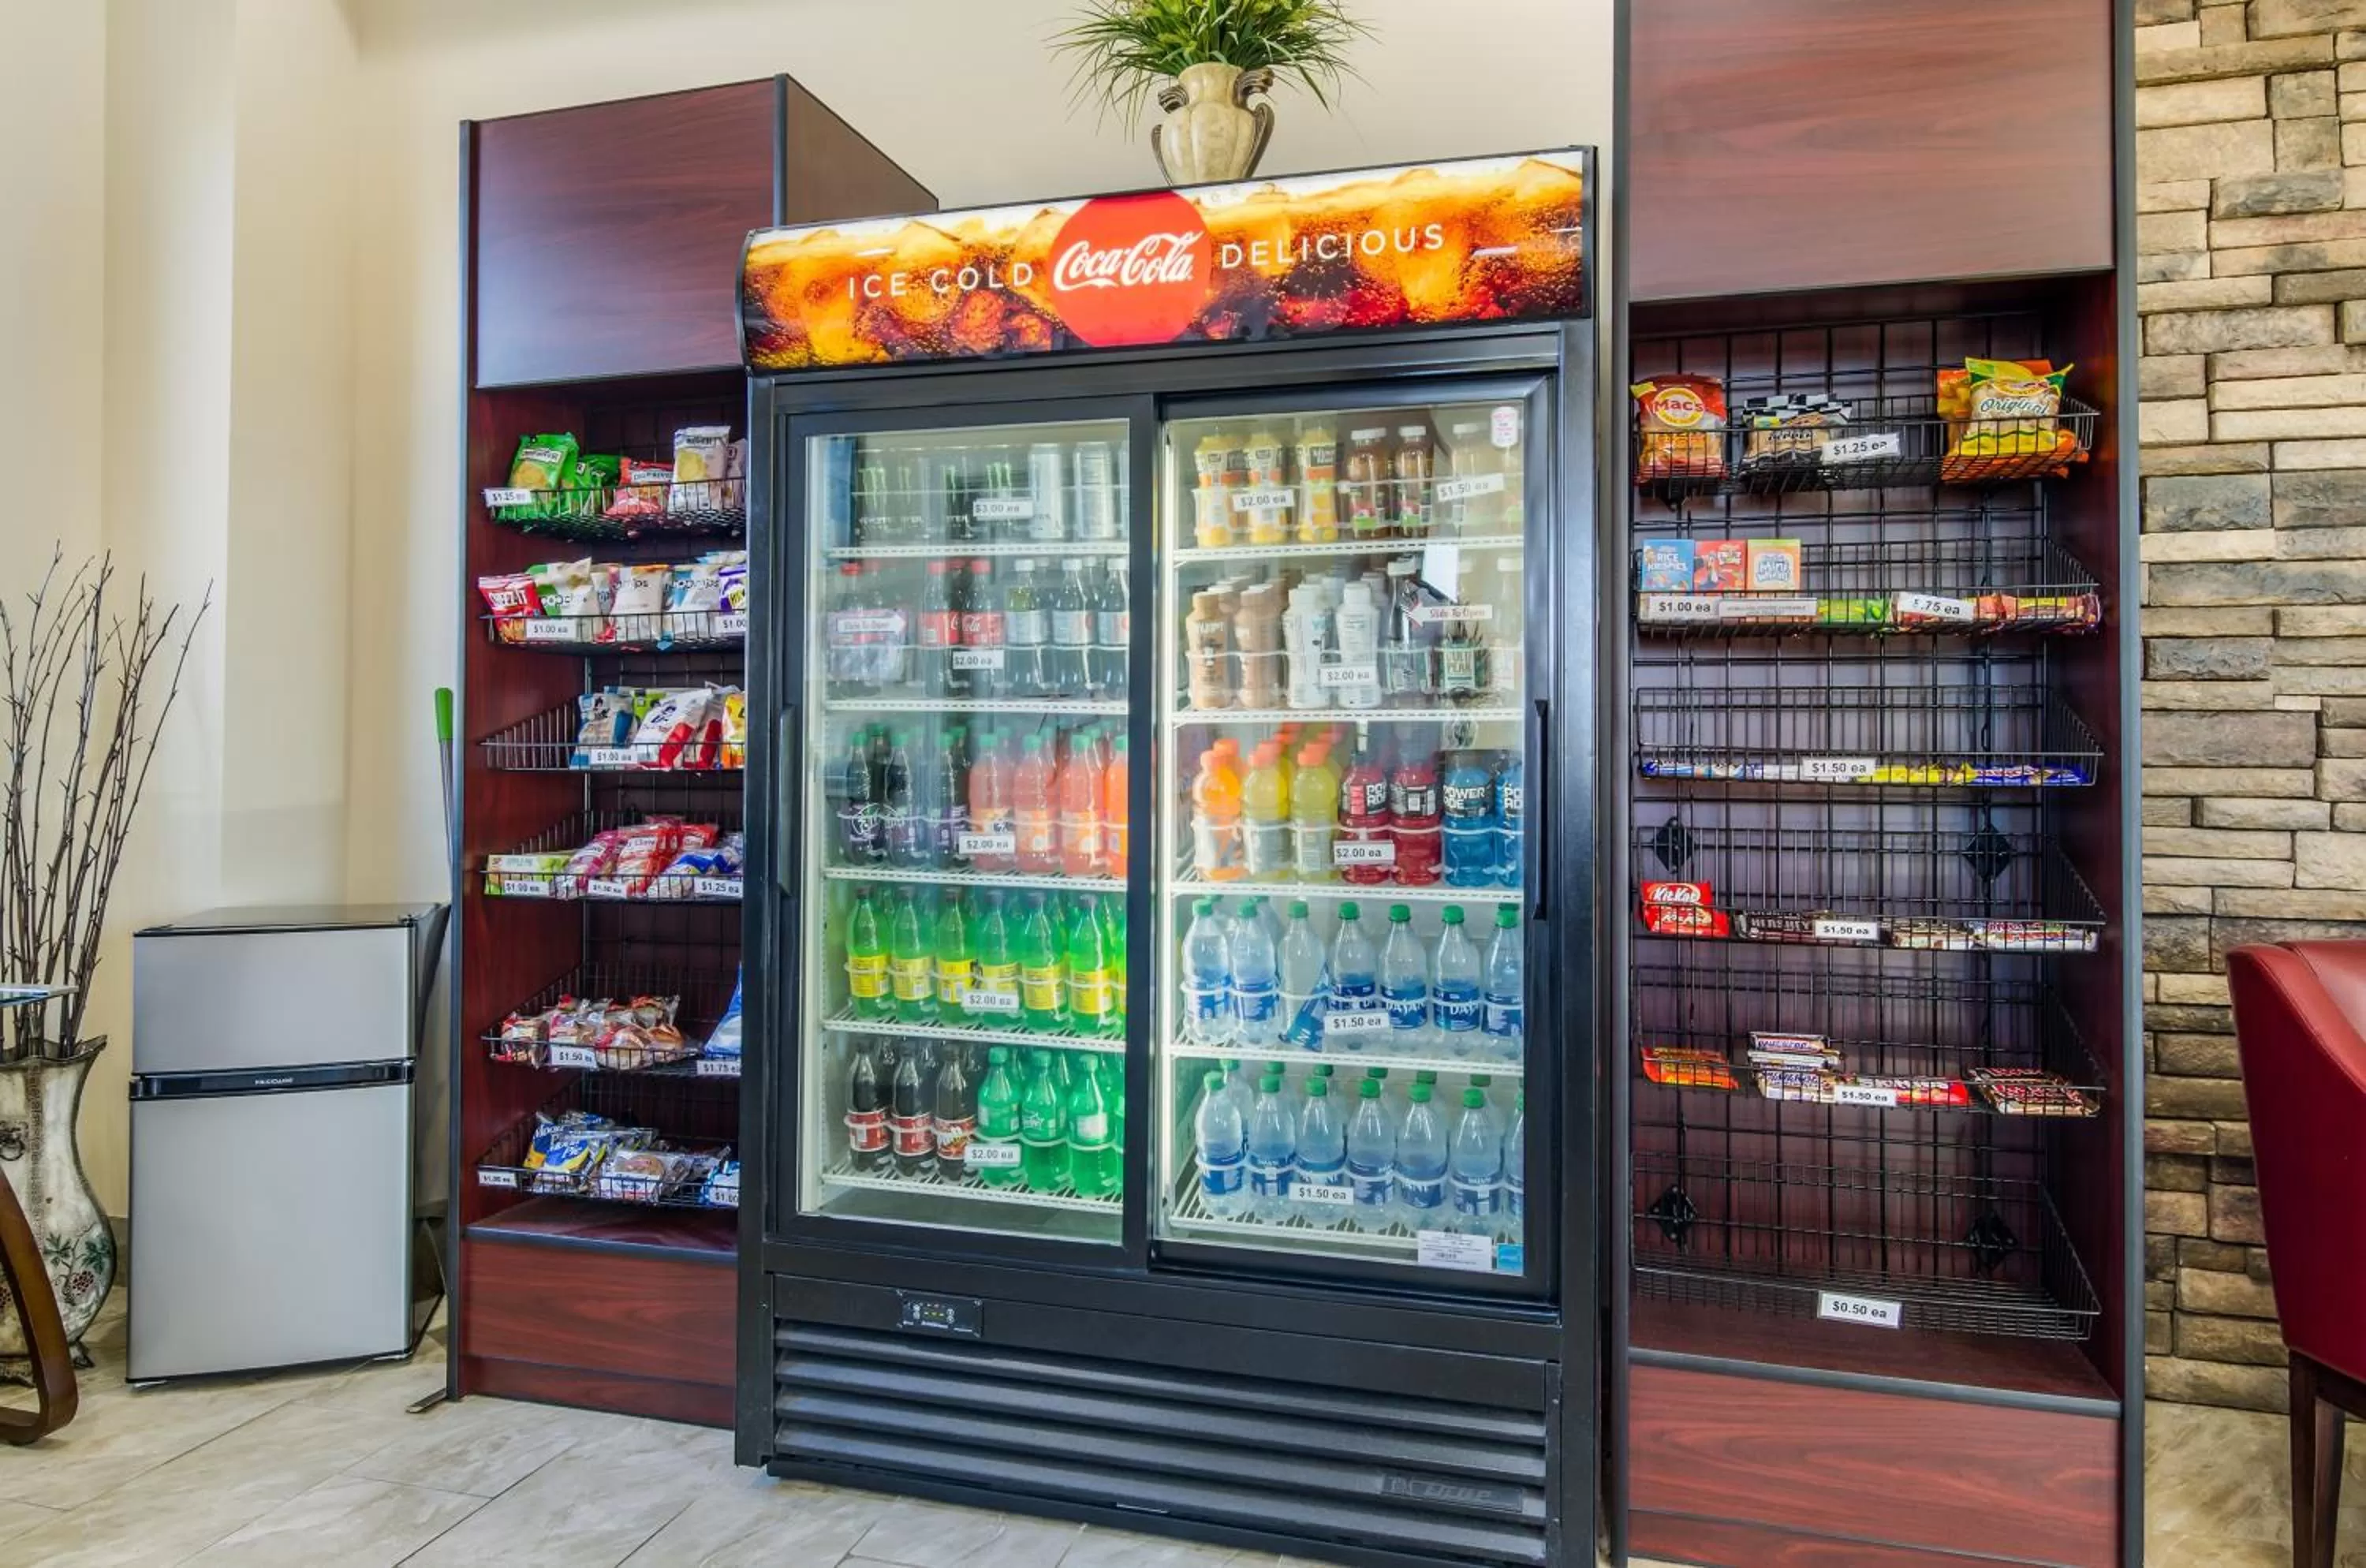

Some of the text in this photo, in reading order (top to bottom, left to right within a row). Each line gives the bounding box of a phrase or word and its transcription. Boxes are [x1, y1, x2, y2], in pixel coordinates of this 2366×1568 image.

[1221, 223, 1446, 271] DELICIOUS
[1053, 228, 1205, 293] Coca-Cola
[847, 262, 1036, 301] ICE COLD
[1655, 398, 1704, 412] Mac's
[1980, 397, 2051, 416] Original
[1832, 439, 1887, 456] $1.25 ea
[1440, 483, 1472, 499] $1.50
[1240, 495, 1271, 507] $2.00
[1659, 602, 1711, 612] $1.00 ea
[1944, 605, 1960, 615] ea
[954, 656, 979, 666] $2.00
[1326, 670, 1355, 681] $2.00
[1812, 763, 1866, 774] $1.50 ea
[1442, 785, 1486, 800] POWER
[965, 838, 995, 849] $2.00
[1336, 848, 1365, 859] $2.00
[701, 882, 726, 893] $1.25
[1823, 925, 1853, 935] $1.50
[969, 995, 997, 1006] $2.00
[1333, 1016, 1381, 1029] $1.50 ea
[558, 1052, 583, 1062] $1.50
[703, 1064, 729, 1073] $1.75
[1842, 1090, 1872, 1100] $1.50
[971, 1149, 999, 1160] $2.00
[1298, 1187, 1347, 1200] $1.50 ea
[1832, 1301, 1887, 1319] $0.50 ea
